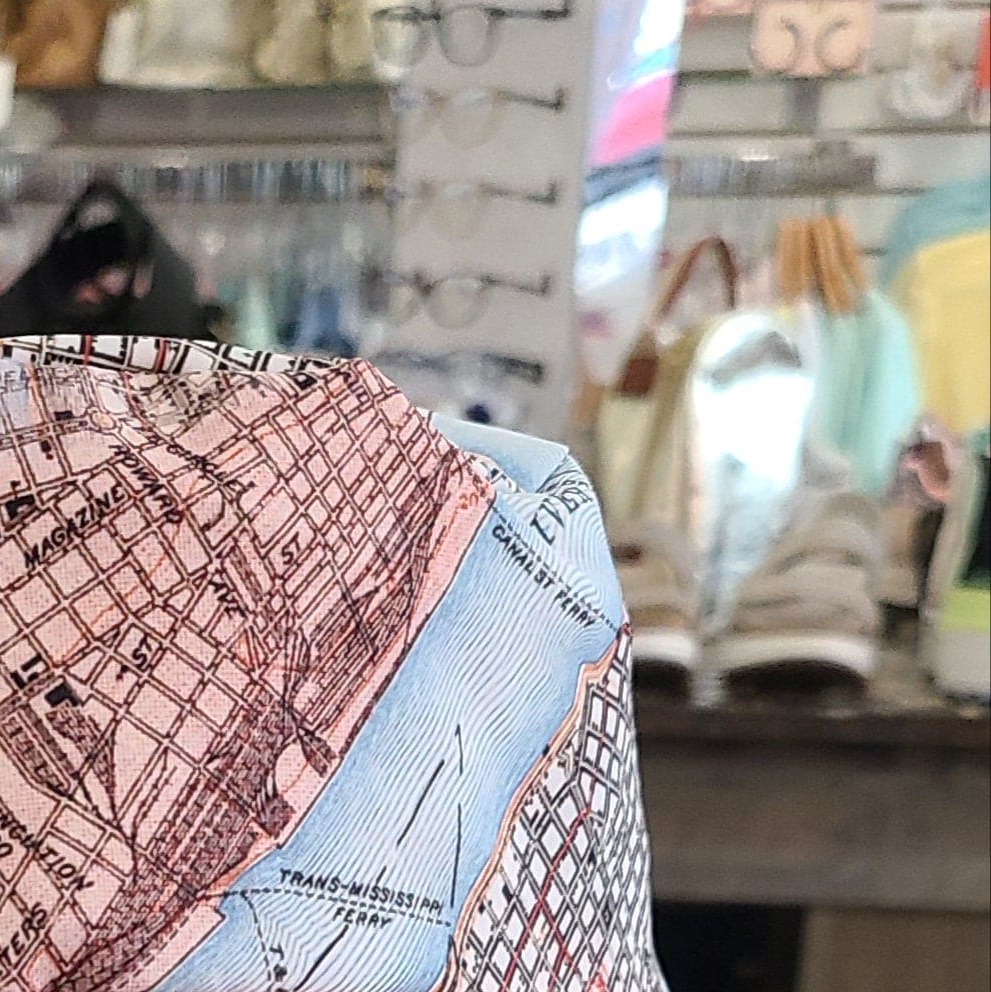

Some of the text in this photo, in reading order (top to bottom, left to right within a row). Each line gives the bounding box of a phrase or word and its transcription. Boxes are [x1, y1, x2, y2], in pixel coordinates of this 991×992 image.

[24, 485, 127, 569] MAGAZINE
[280, 531, 305, 565] ST
[492, 524, 596, 629] CANAL ST FERRY
[131, 635, 153, 670] ST
[279, 868, 444, 916] TRANS-MISSISSIPPI
[332, 907, 393, 930] FERRY
